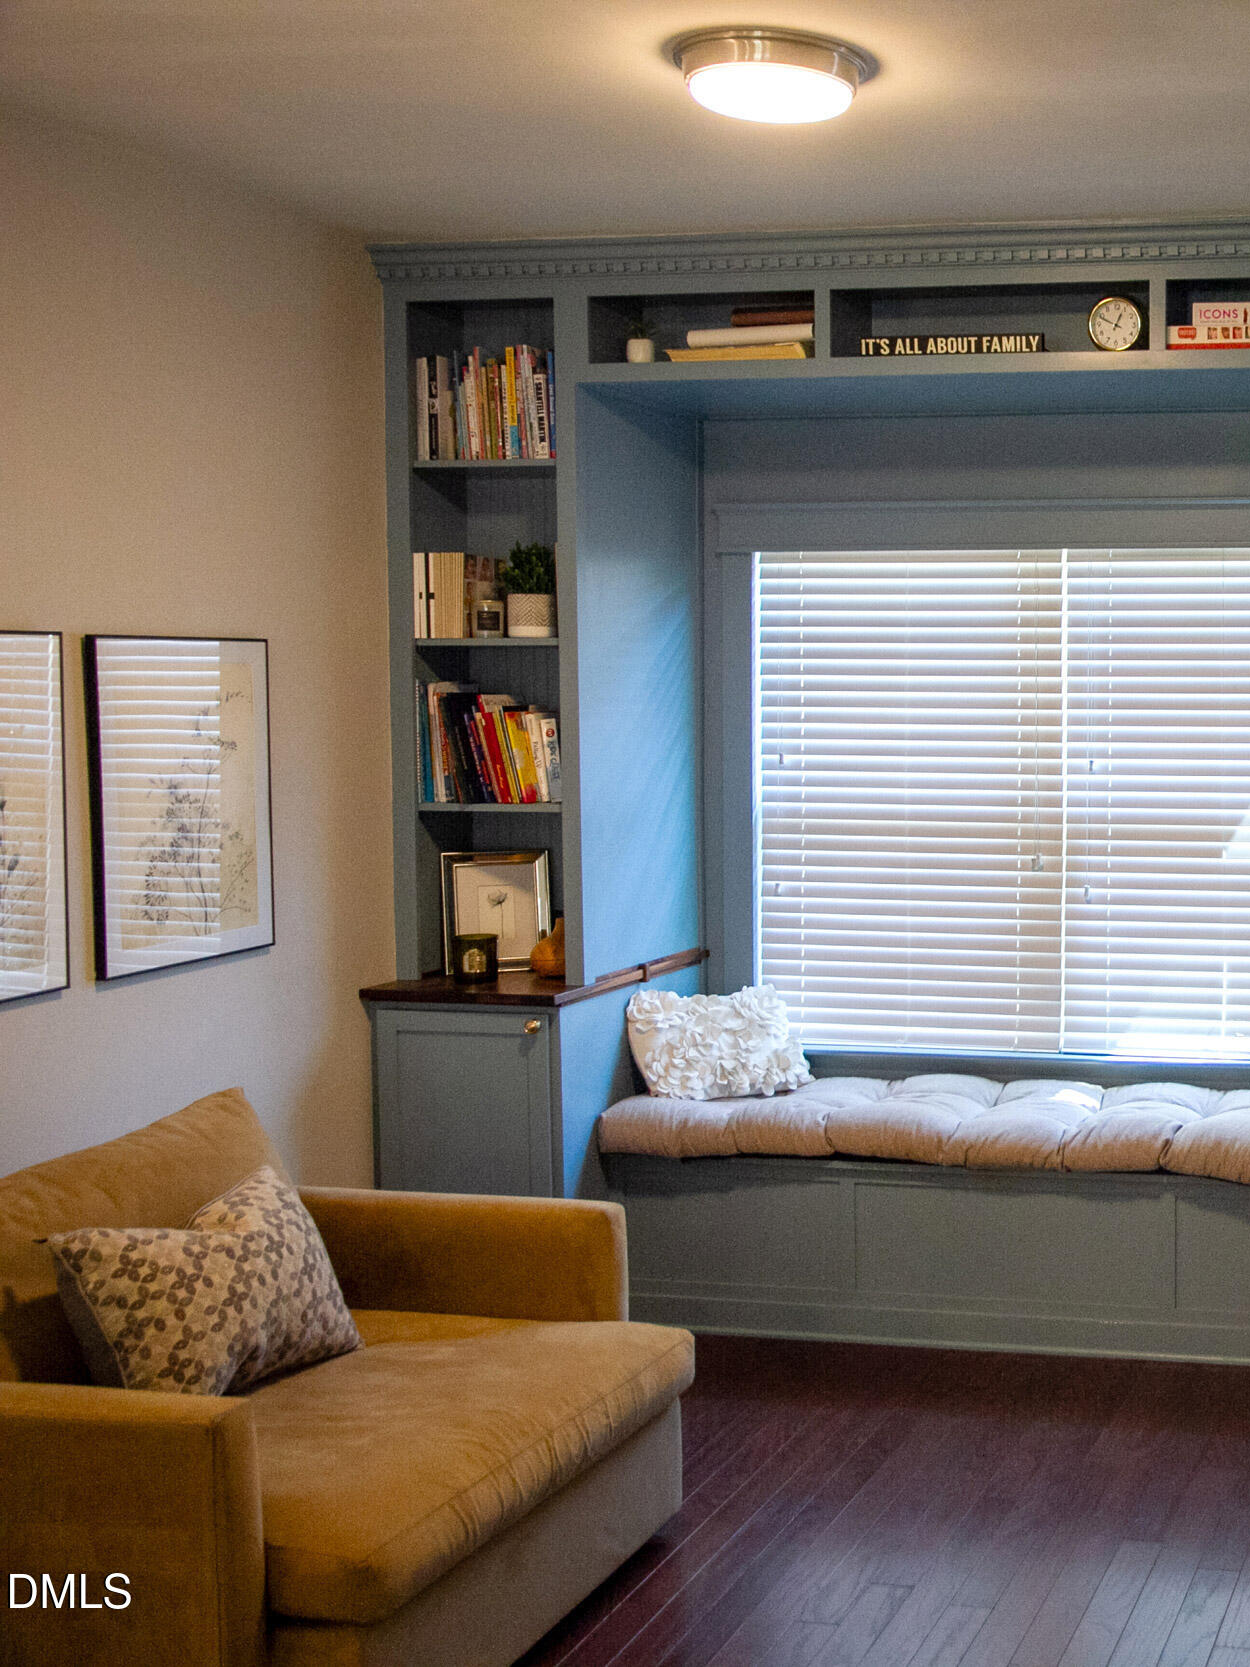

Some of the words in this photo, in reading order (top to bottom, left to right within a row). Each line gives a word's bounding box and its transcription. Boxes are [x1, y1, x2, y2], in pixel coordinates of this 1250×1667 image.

[1200, 308, 1238, 319] ICONS
[860, 338, 890, 355] IT'S
[894, 337, 922, 355] ALL
[926, 336, 977, 354] ABOUT
[982, 335, 1040, 353] FAMILY
[538, 416, 547, 444] MARTIN
